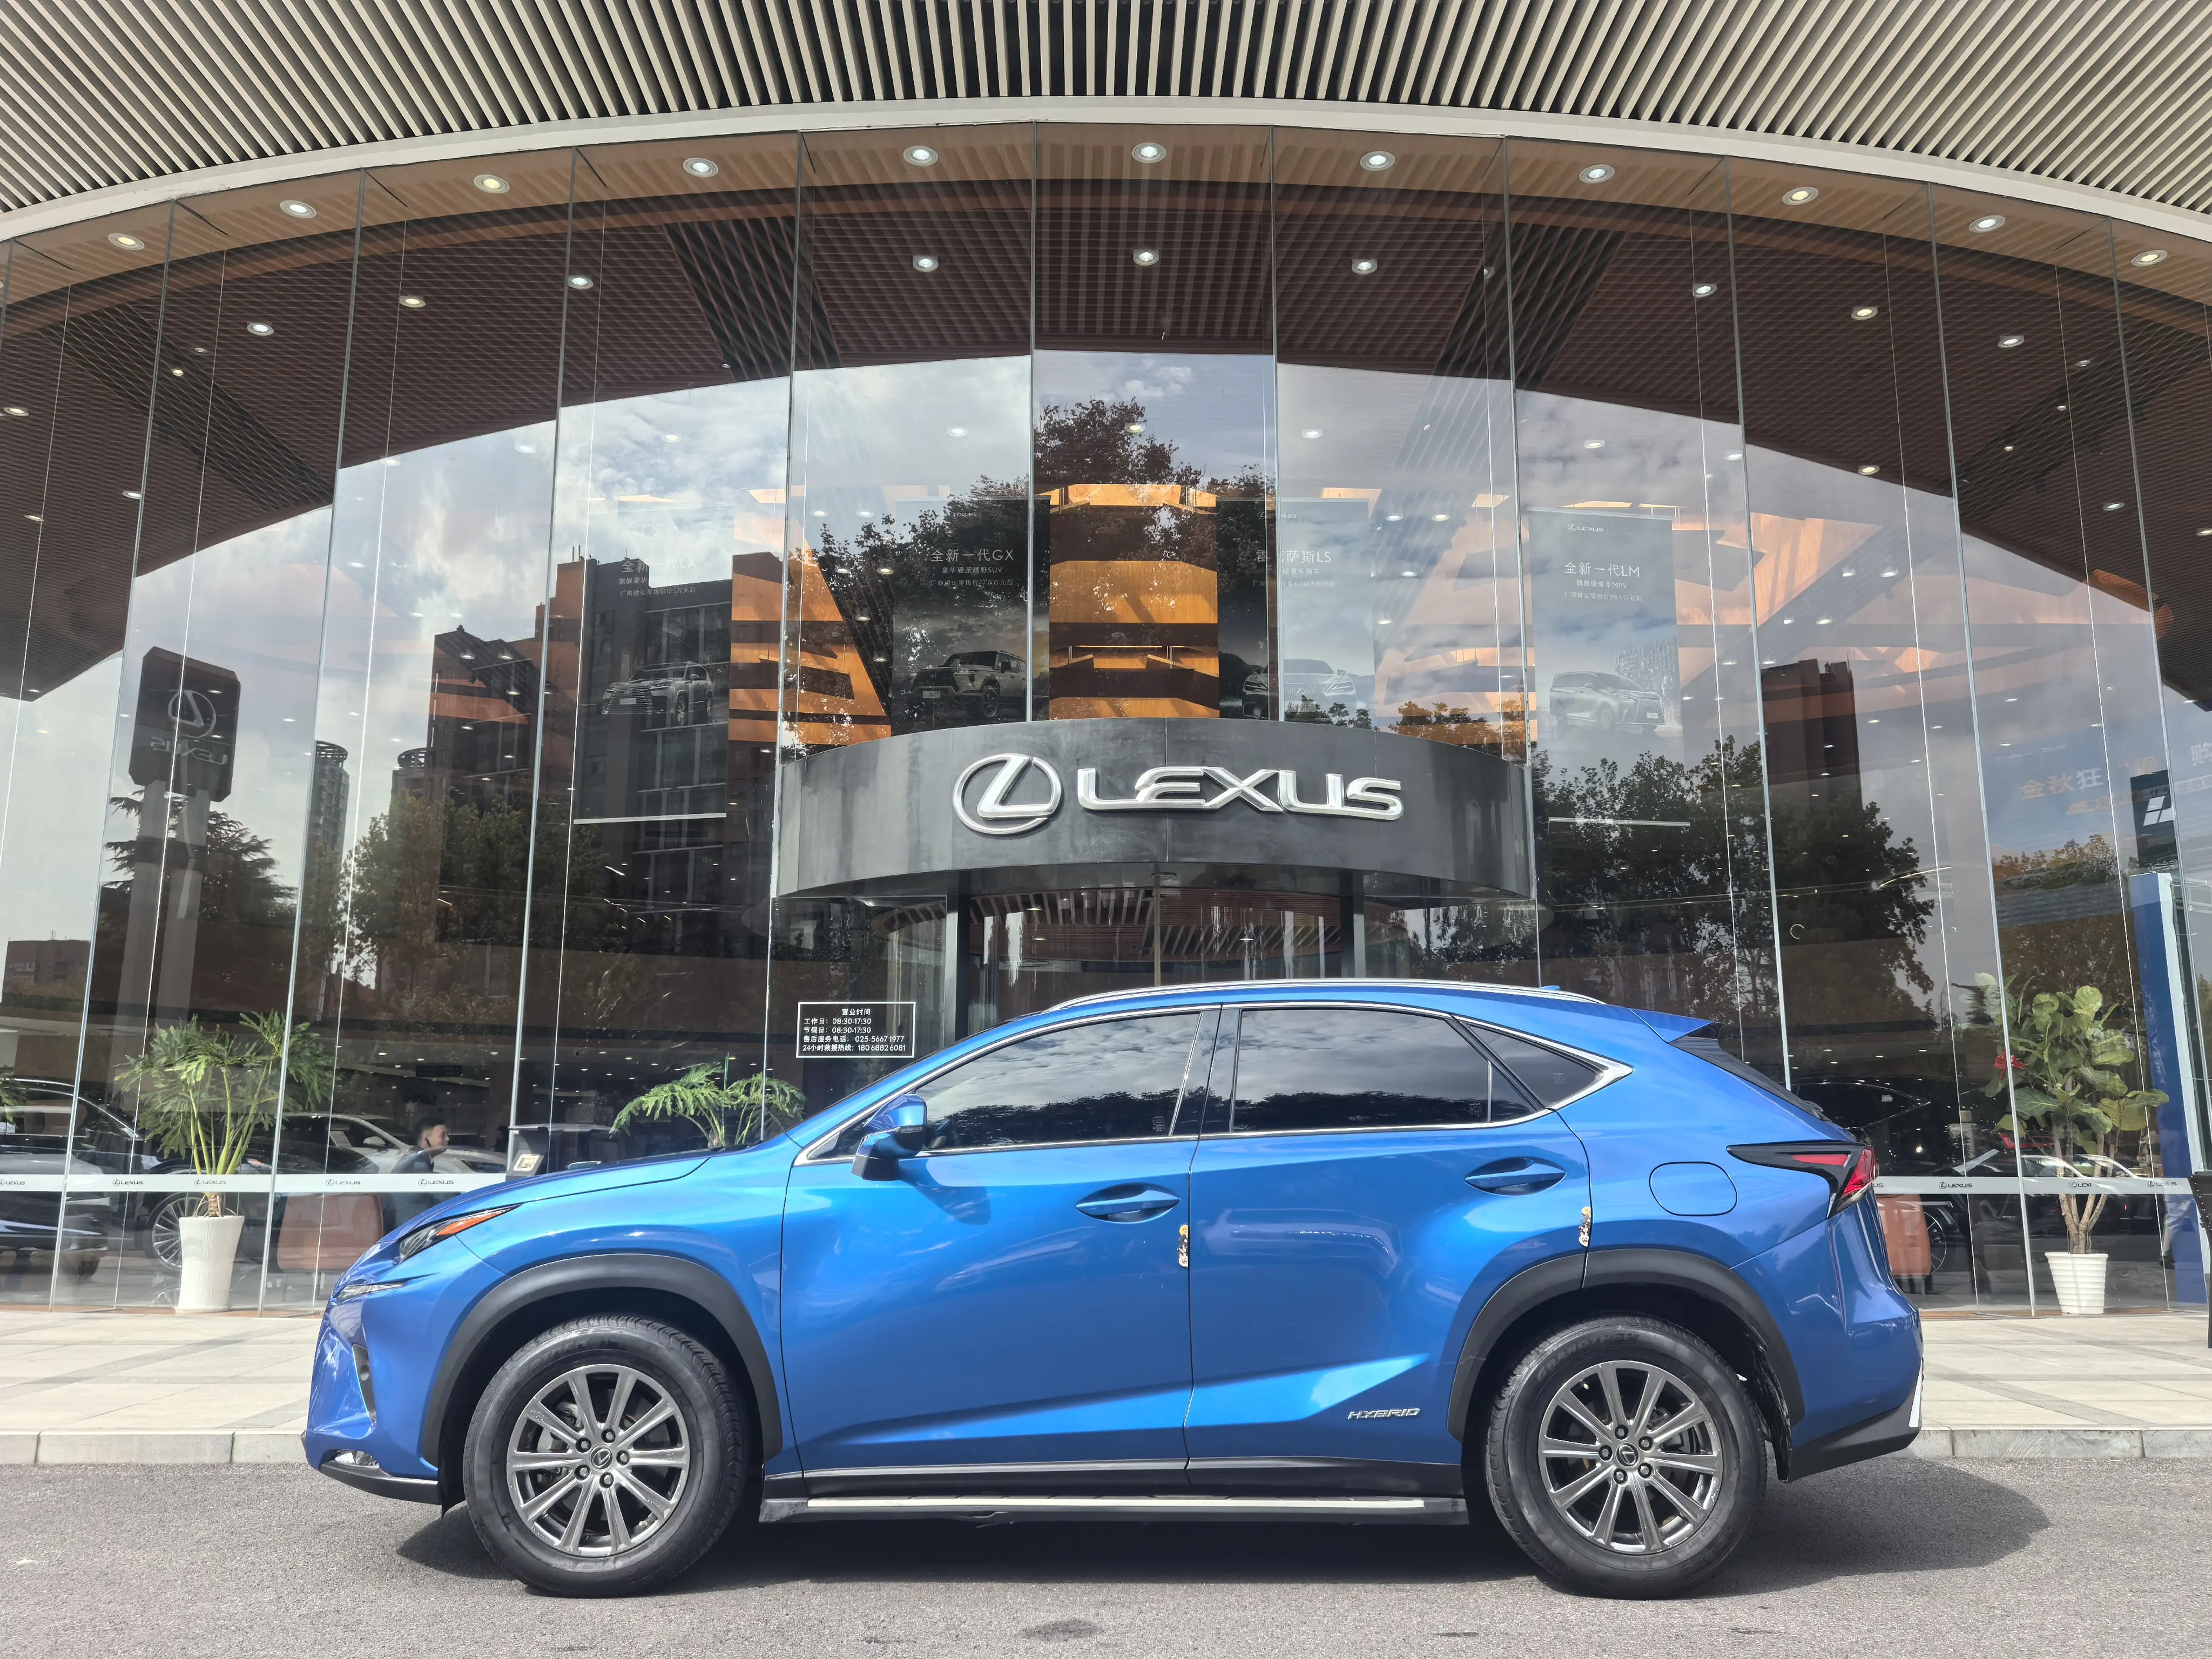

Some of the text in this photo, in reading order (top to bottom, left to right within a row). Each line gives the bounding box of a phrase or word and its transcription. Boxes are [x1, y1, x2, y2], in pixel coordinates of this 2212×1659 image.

[930, 548, 1014, 562] 全新一代GX
[1256, 549, 1332, 563] 雷萨斯LS
[1564, 561, 1640, 577] 全新一代LM
[1078, 766, 1404, 821] LEXUS
[841, 1008, 871, 1016] 营业时间
[1347, 1407, 1421, 1420] HYBRID
